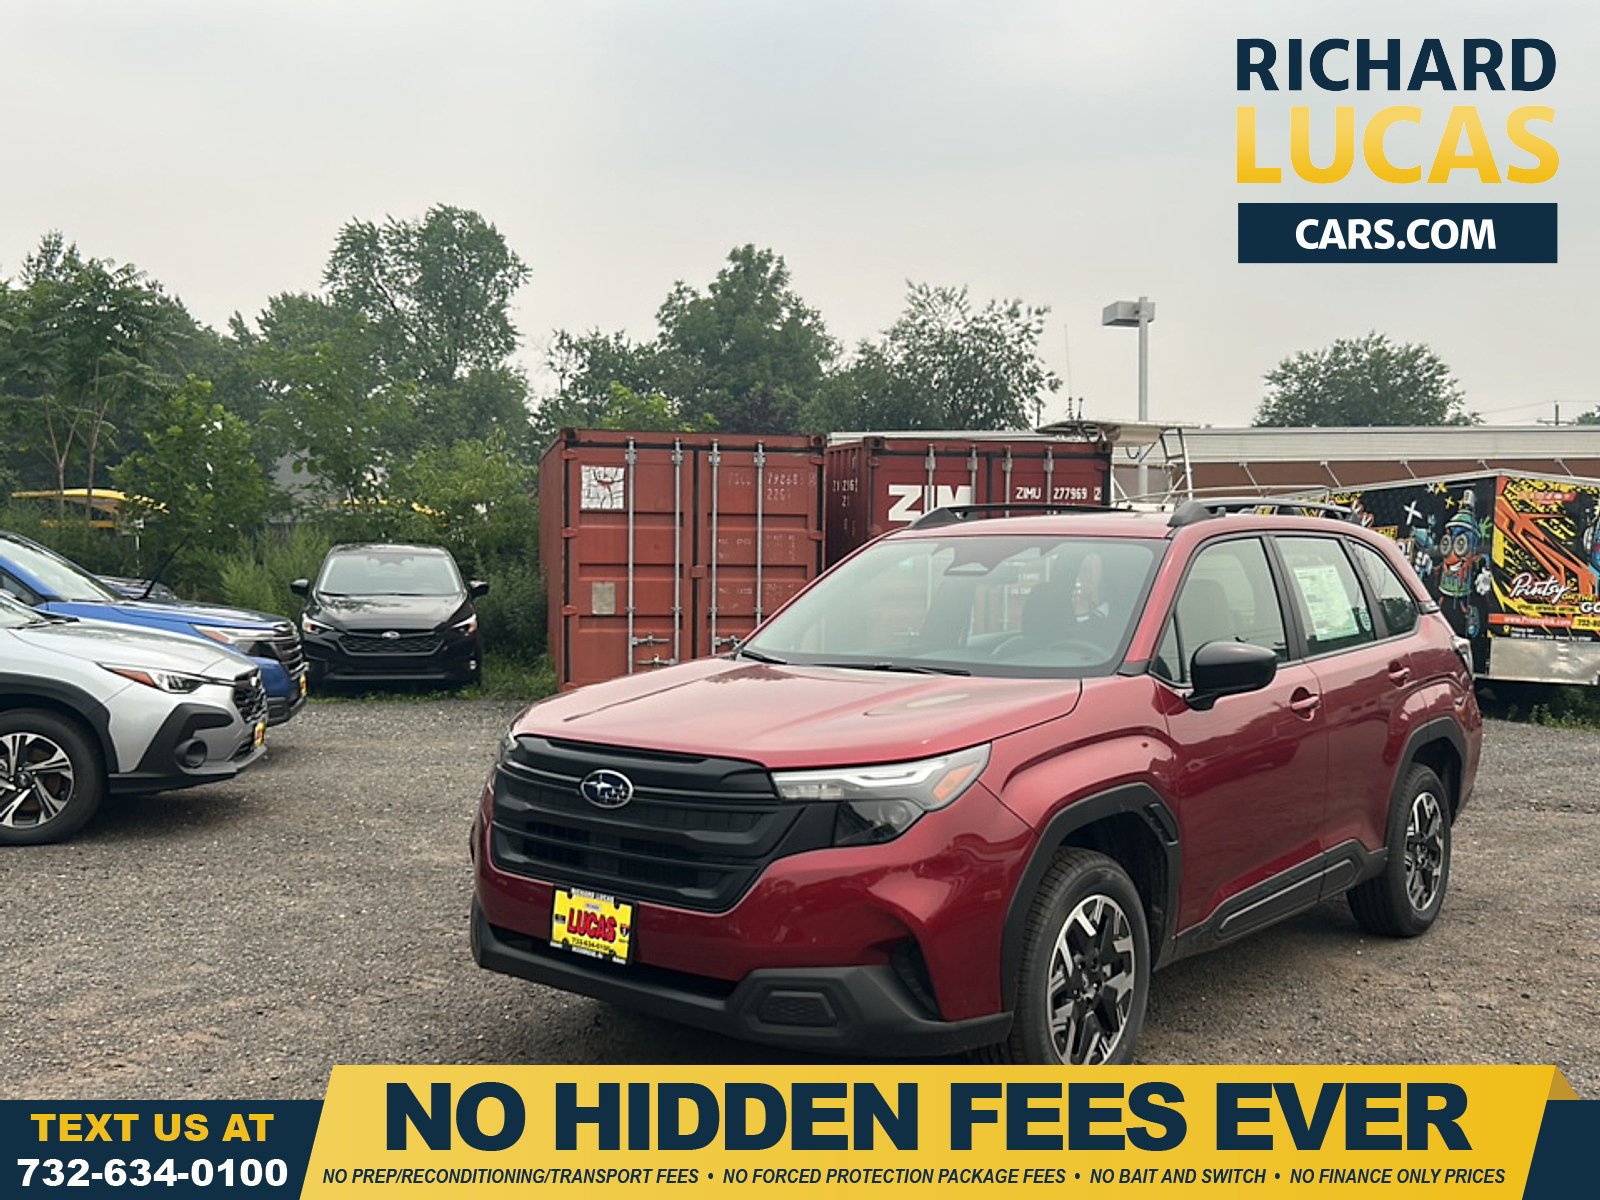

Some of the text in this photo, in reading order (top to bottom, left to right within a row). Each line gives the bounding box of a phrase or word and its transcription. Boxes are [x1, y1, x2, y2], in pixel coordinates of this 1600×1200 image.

[888, 484, 974, 523] ZIM
[1016, 486, 1042, 501] ZIMU
[1053, 486, 1088, 501] 277969
[567, 908, 617, 943] LUCAS
